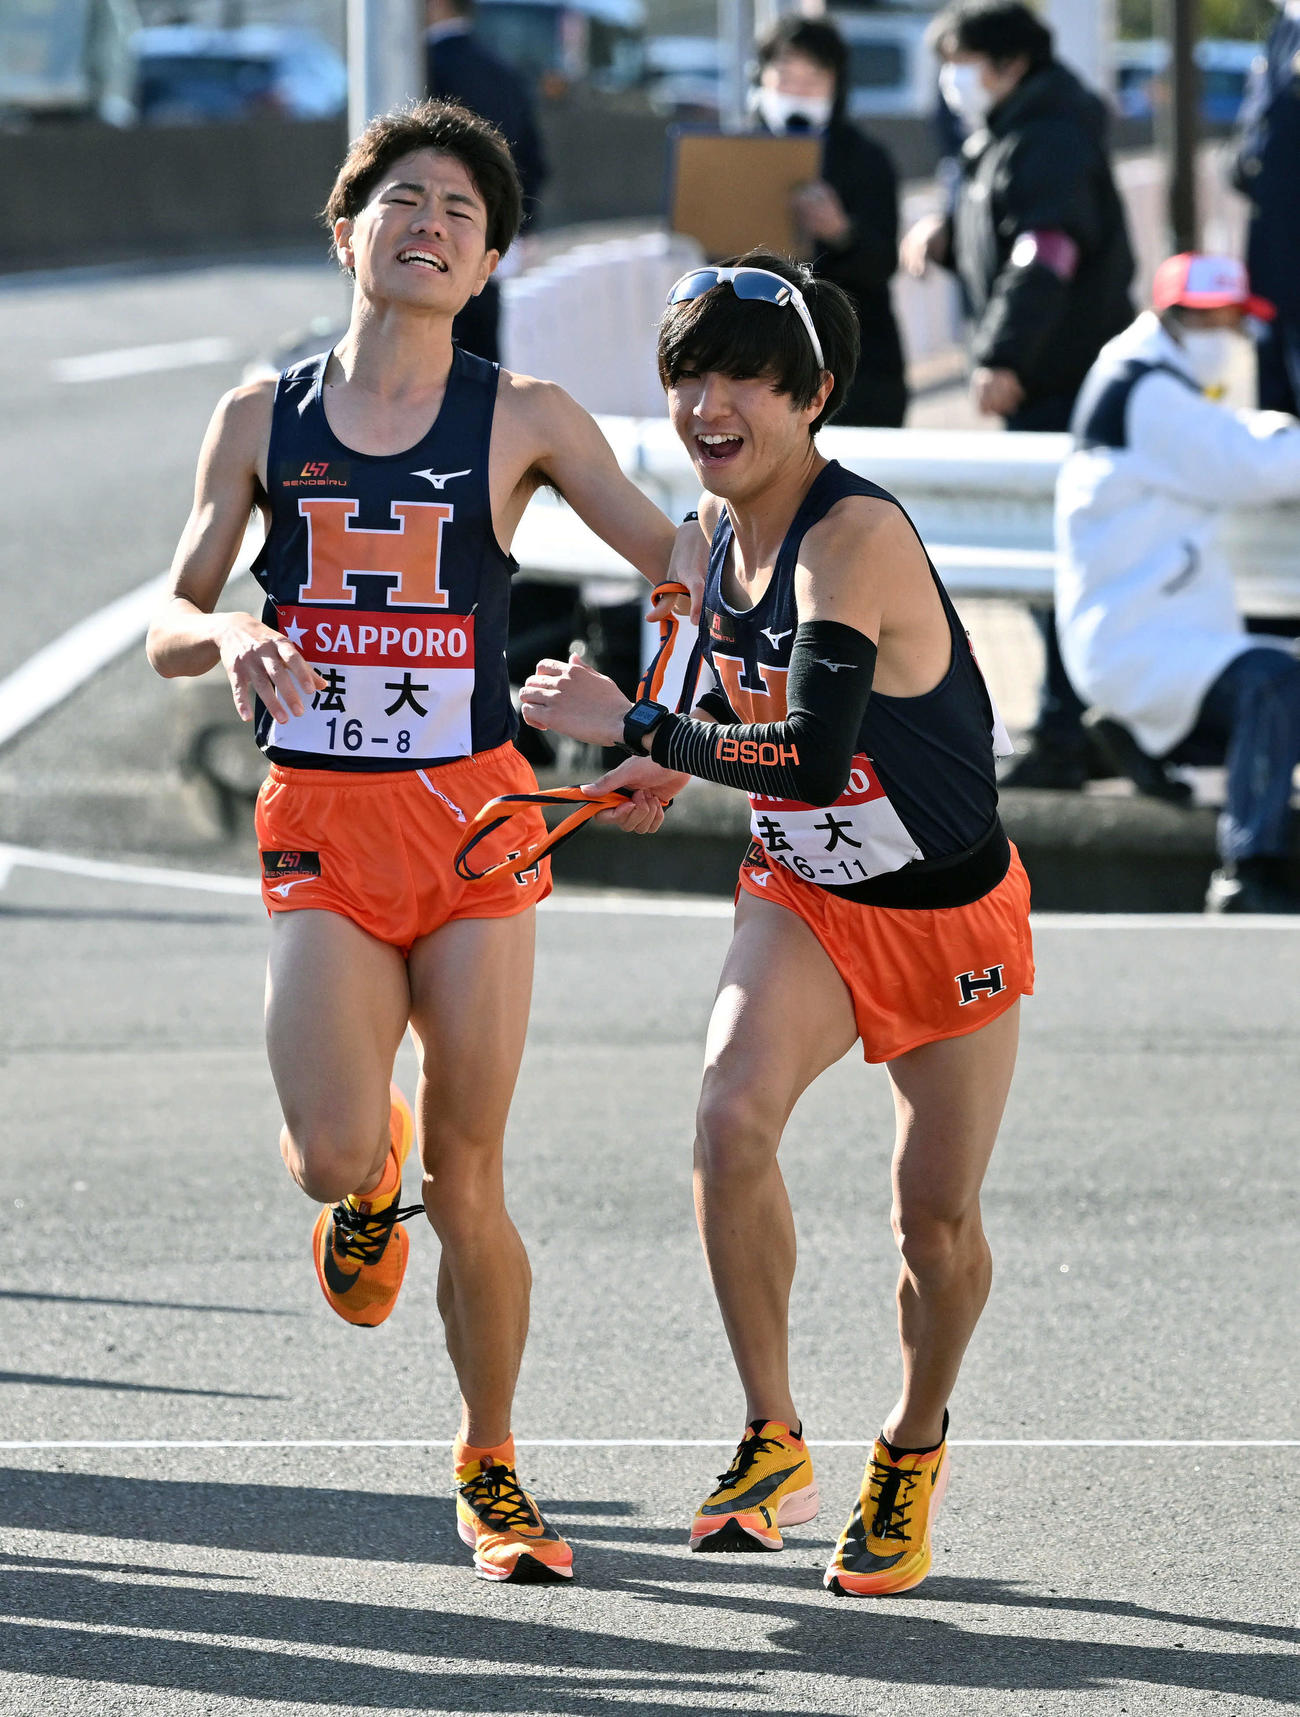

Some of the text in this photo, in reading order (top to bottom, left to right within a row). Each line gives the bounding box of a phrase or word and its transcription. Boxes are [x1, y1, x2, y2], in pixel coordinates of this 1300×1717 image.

[298, 498, 454, 609] H
[315, 622, 467, 658] SAPPORO
[326, 717, 411, 754] 16-8
[716, 738, 800, 767] HOSEI
[776, 854, 868, 880] 16-11
[954, 964, 1007, 1006] H
